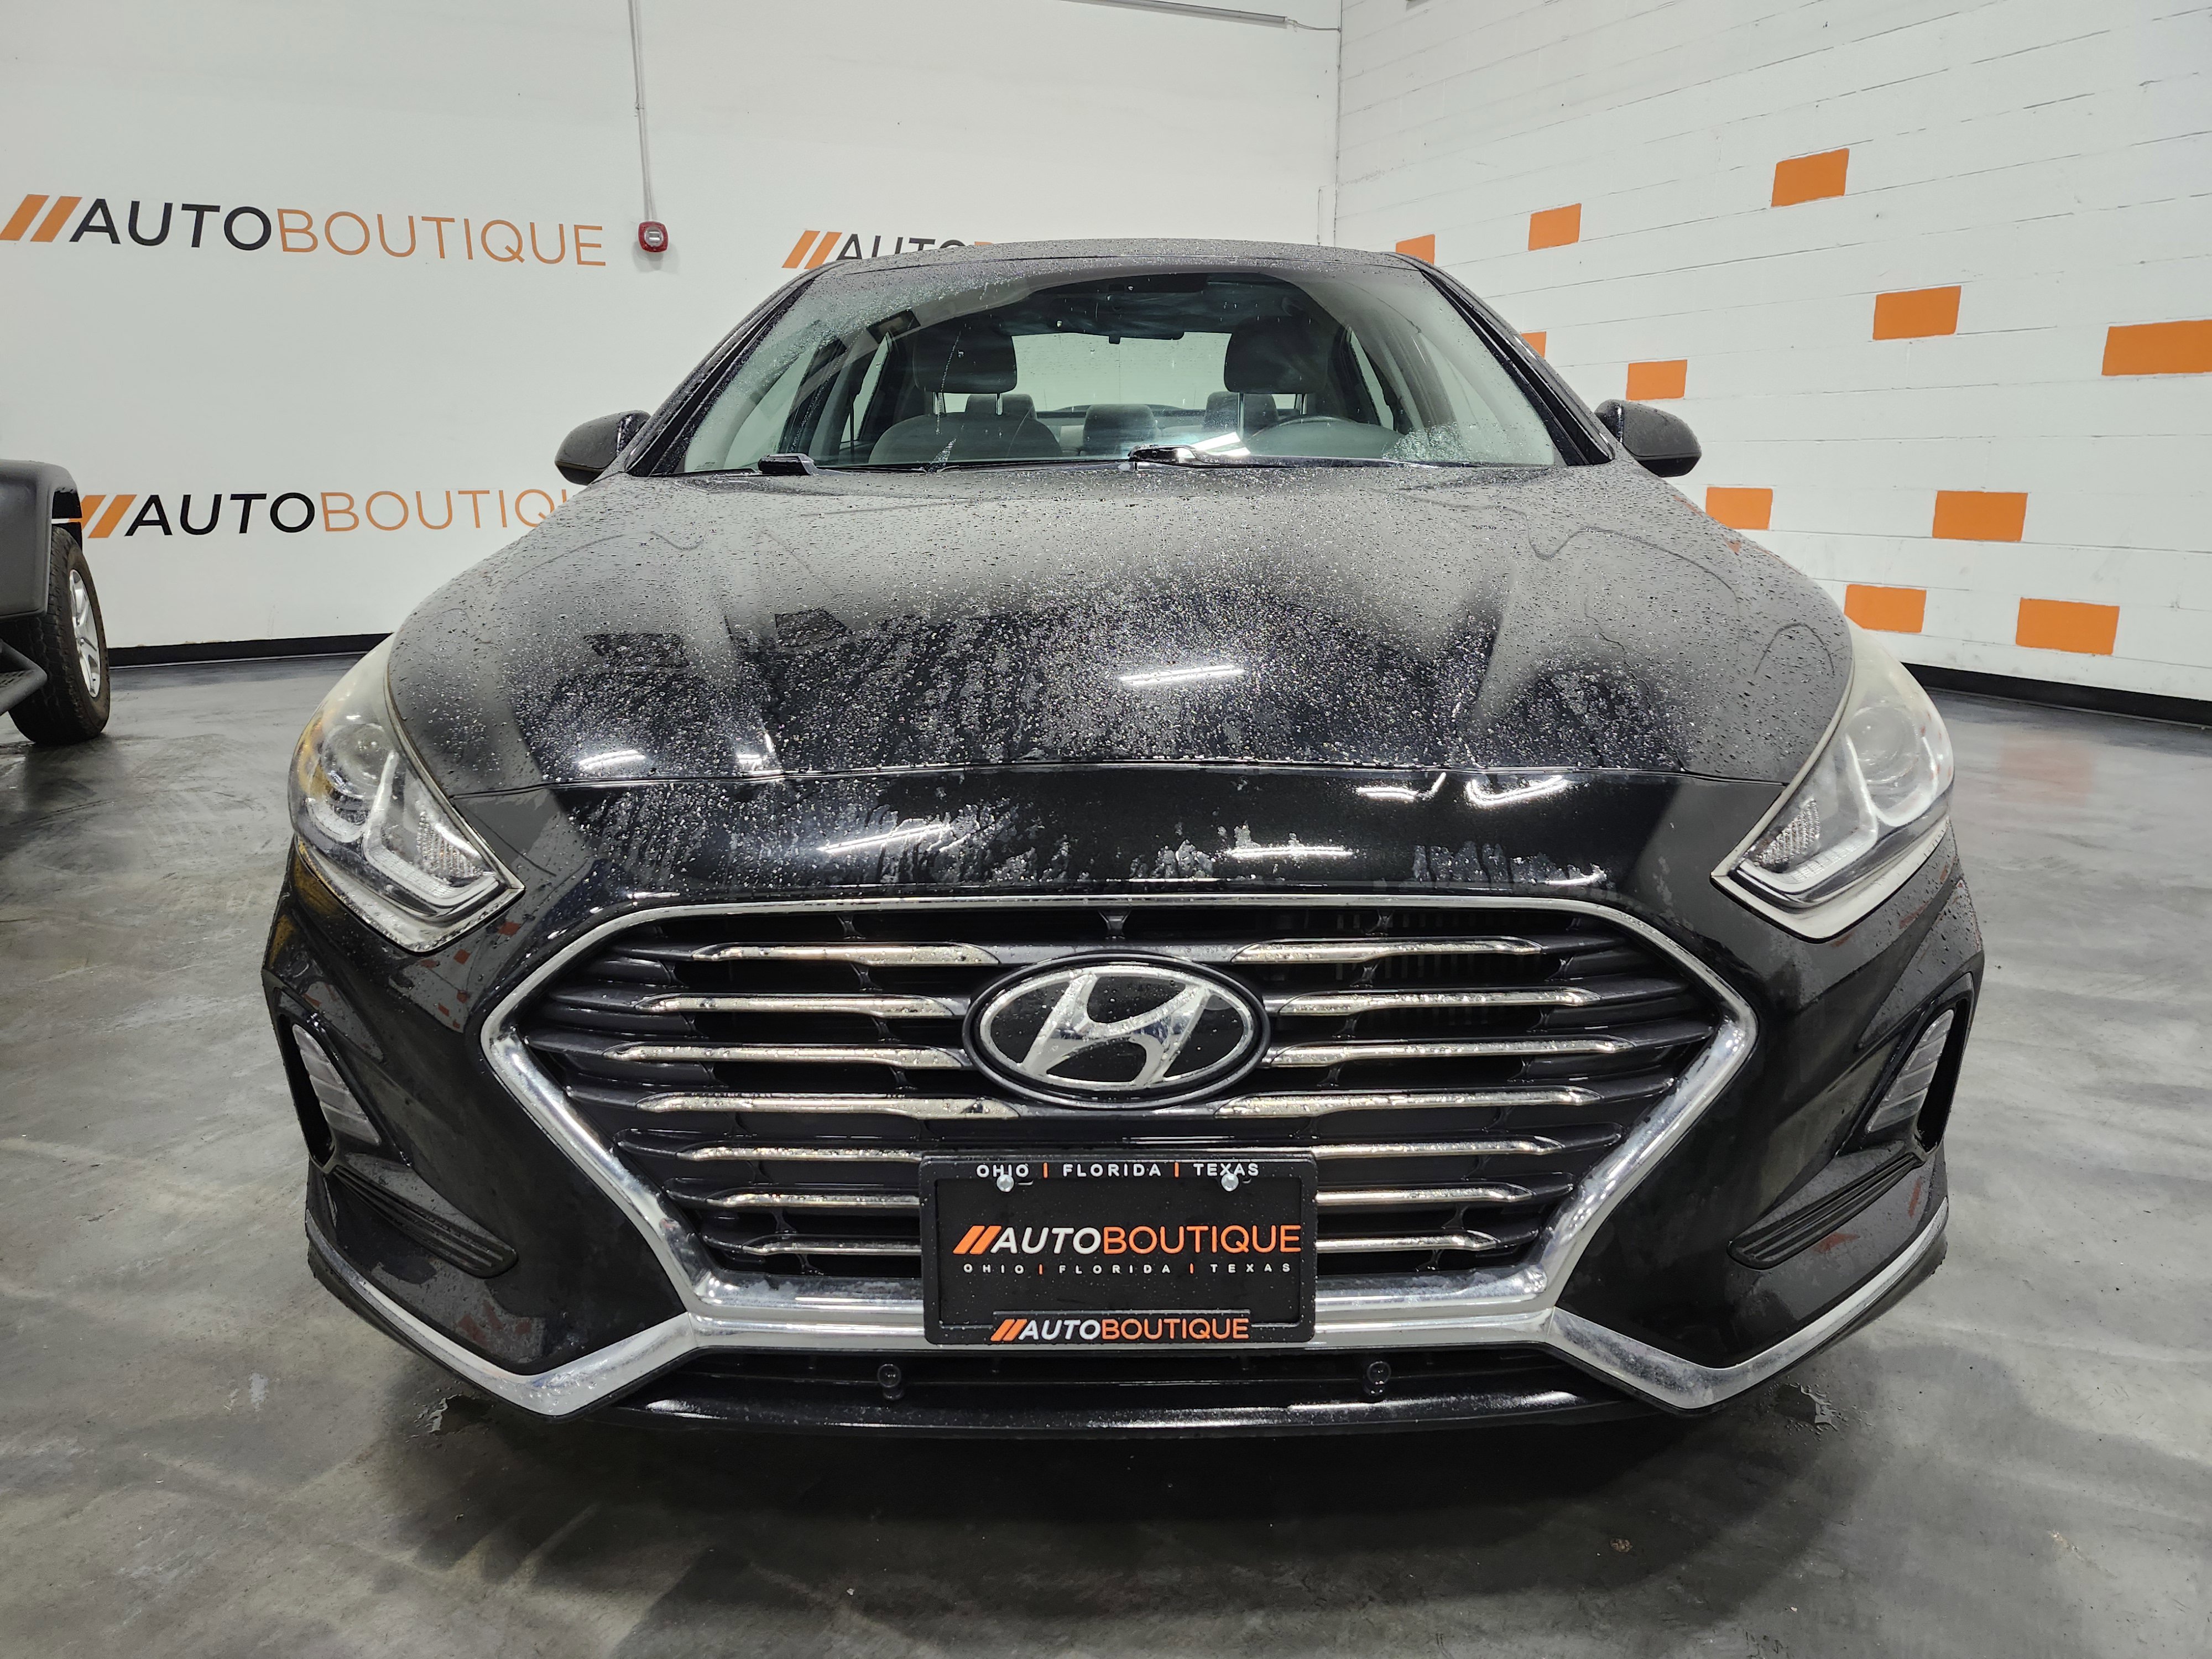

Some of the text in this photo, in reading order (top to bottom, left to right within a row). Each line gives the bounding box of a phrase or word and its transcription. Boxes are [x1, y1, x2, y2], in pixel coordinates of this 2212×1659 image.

[69, 197, 606, 266] AUTOBOUTIQUE
[125, 489, 567, 536] AUTOBOUTIQ
[976, 1163, 1259, 1177] OHIO FLORIDA TEXAS
[990, 1225, 1301, 1254] AUTOBOUTIQUE
[963, 1263, 1291, 1274] OHIO FLORIDA TEXAS
[1019, 1318, 1249, 1340] AUTOBOUTIQUE
